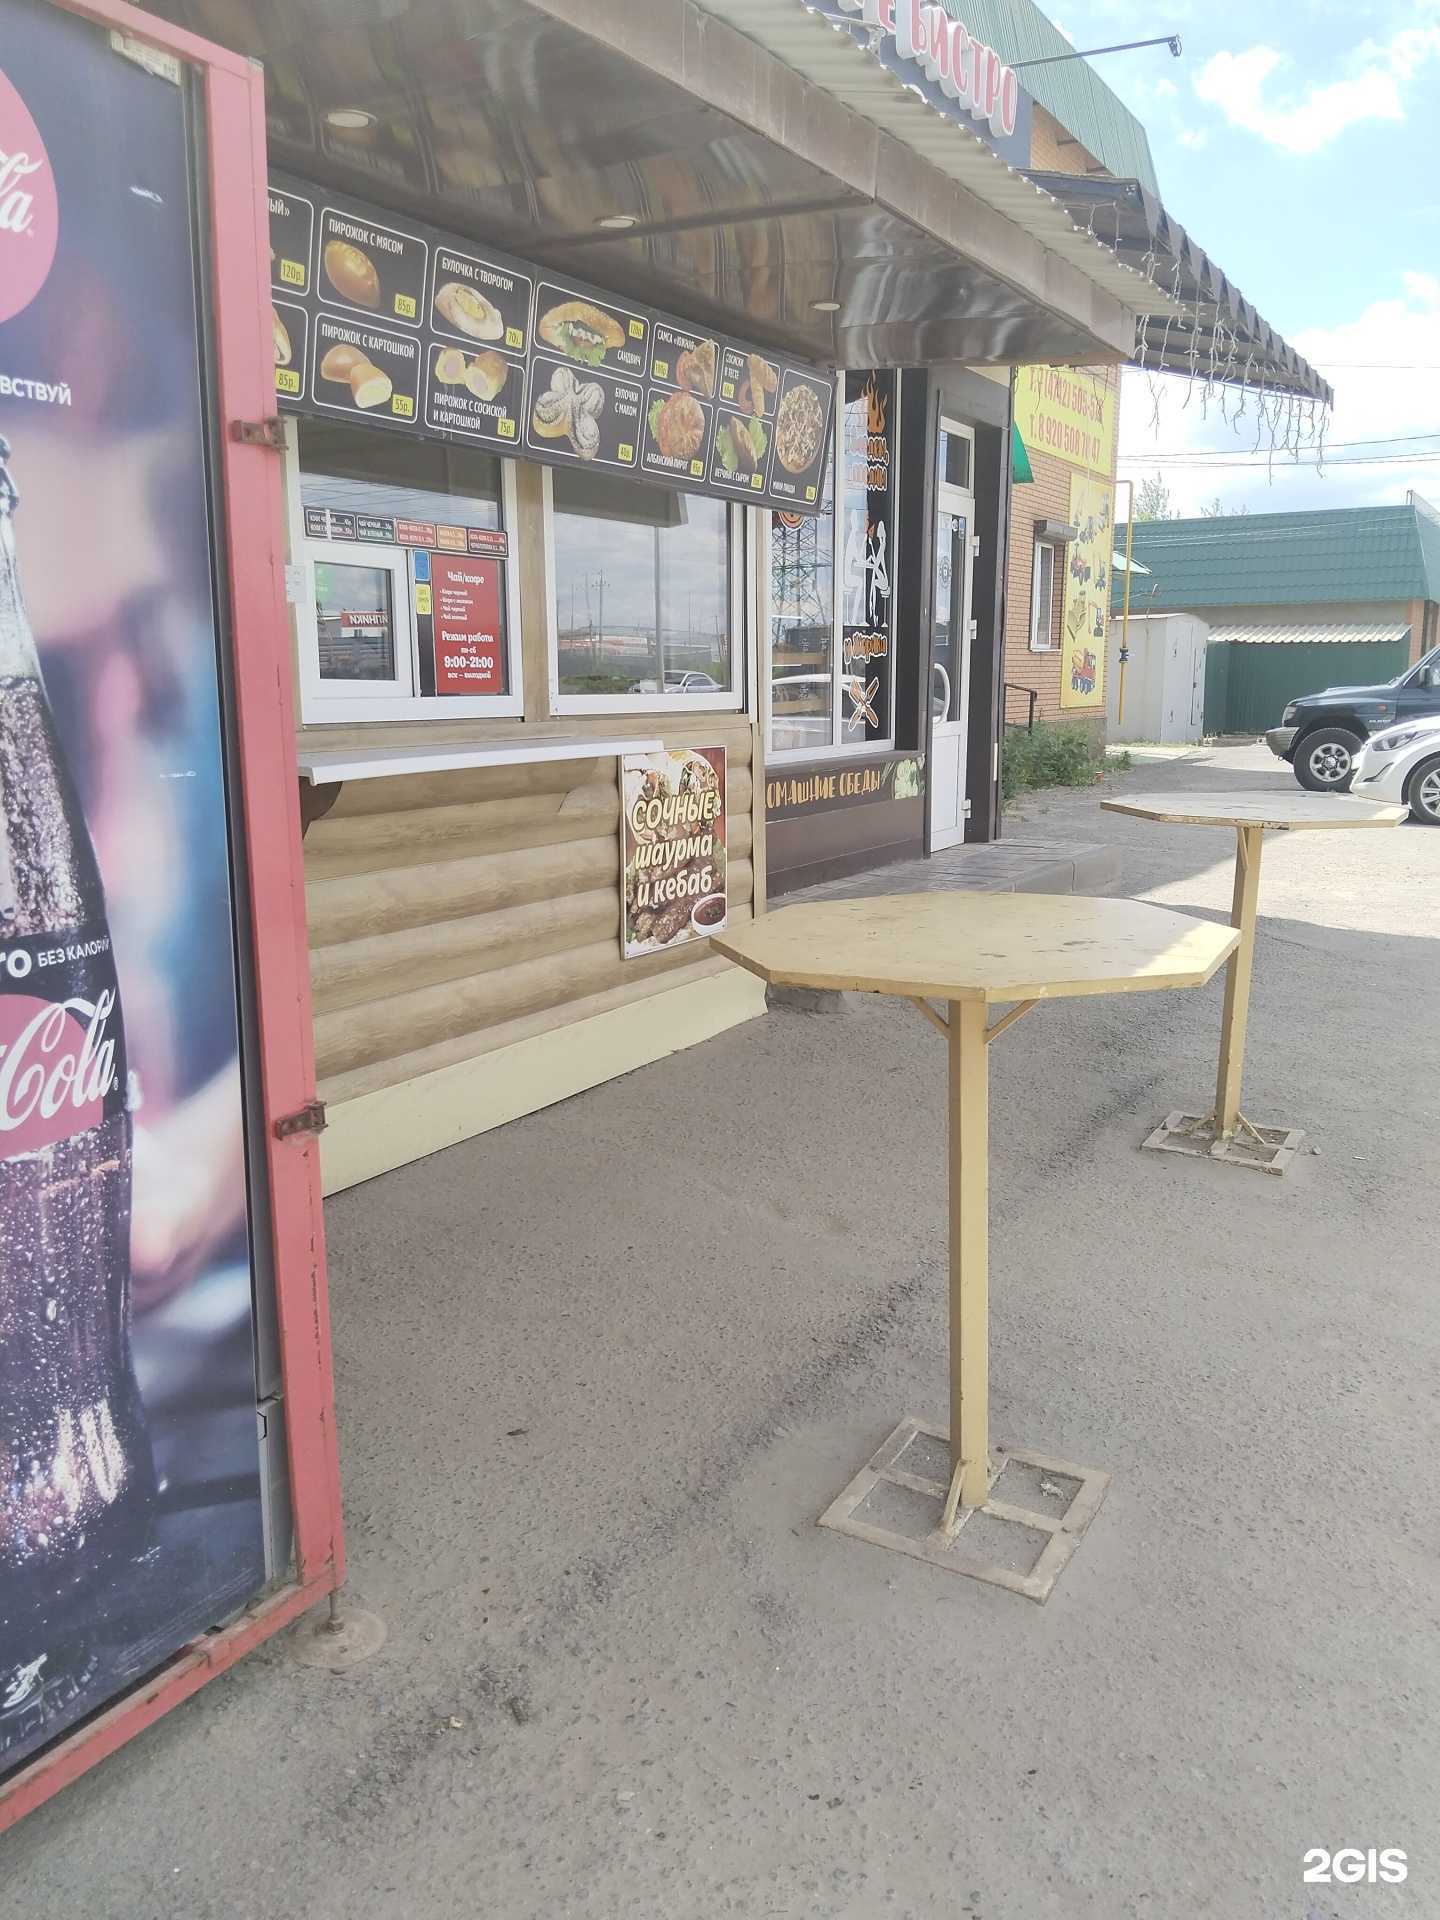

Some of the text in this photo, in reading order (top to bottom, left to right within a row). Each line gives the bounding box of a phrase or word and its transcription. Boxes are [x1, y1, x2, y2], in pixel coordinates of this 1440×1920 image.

[329, 218, 404, 255] ПИРОЖОК С МЯСОМ
[282, 264, 304, 284] 120р.
[442, 257, 514, 292] БУЛОЧКА С ТВОРОГОМ
[322, 323, 415, 359] ПИРОЖОК С КАРТОШКОЙ
[657, 329, 673, 344] САМСА
[617, 350, 641, 367] САНДВИЧ
[0, 374, 72, 407] ВСТВУЙ
[434, 392, 507, 419] ПИРОЖОК С СОСИСКОЙ
[614, 387, 639, 402] БУЛОЧКИ
[433, 409, 480, 430] И КАРТОШКОЙ
[447, 570, 485, 586] Чай/кофе
[442, 630, 494, 644] Режим работы
[444, 655, 494, 669] 9:00-21:00
[764, 768, 880, 809] ОМАШНИЕ ОБЕДЫ
[632, 789, 715, 833] СОЧНЫЕ
[635, 834, 713, 871] шаурма
[637, 865, 713, 908] и кебаб
[37, 947, 66, 968] БЕЗ
[66, 935, 110, 961] КАЛОРИЙ
[0, 988, 117, 1131] Cola
